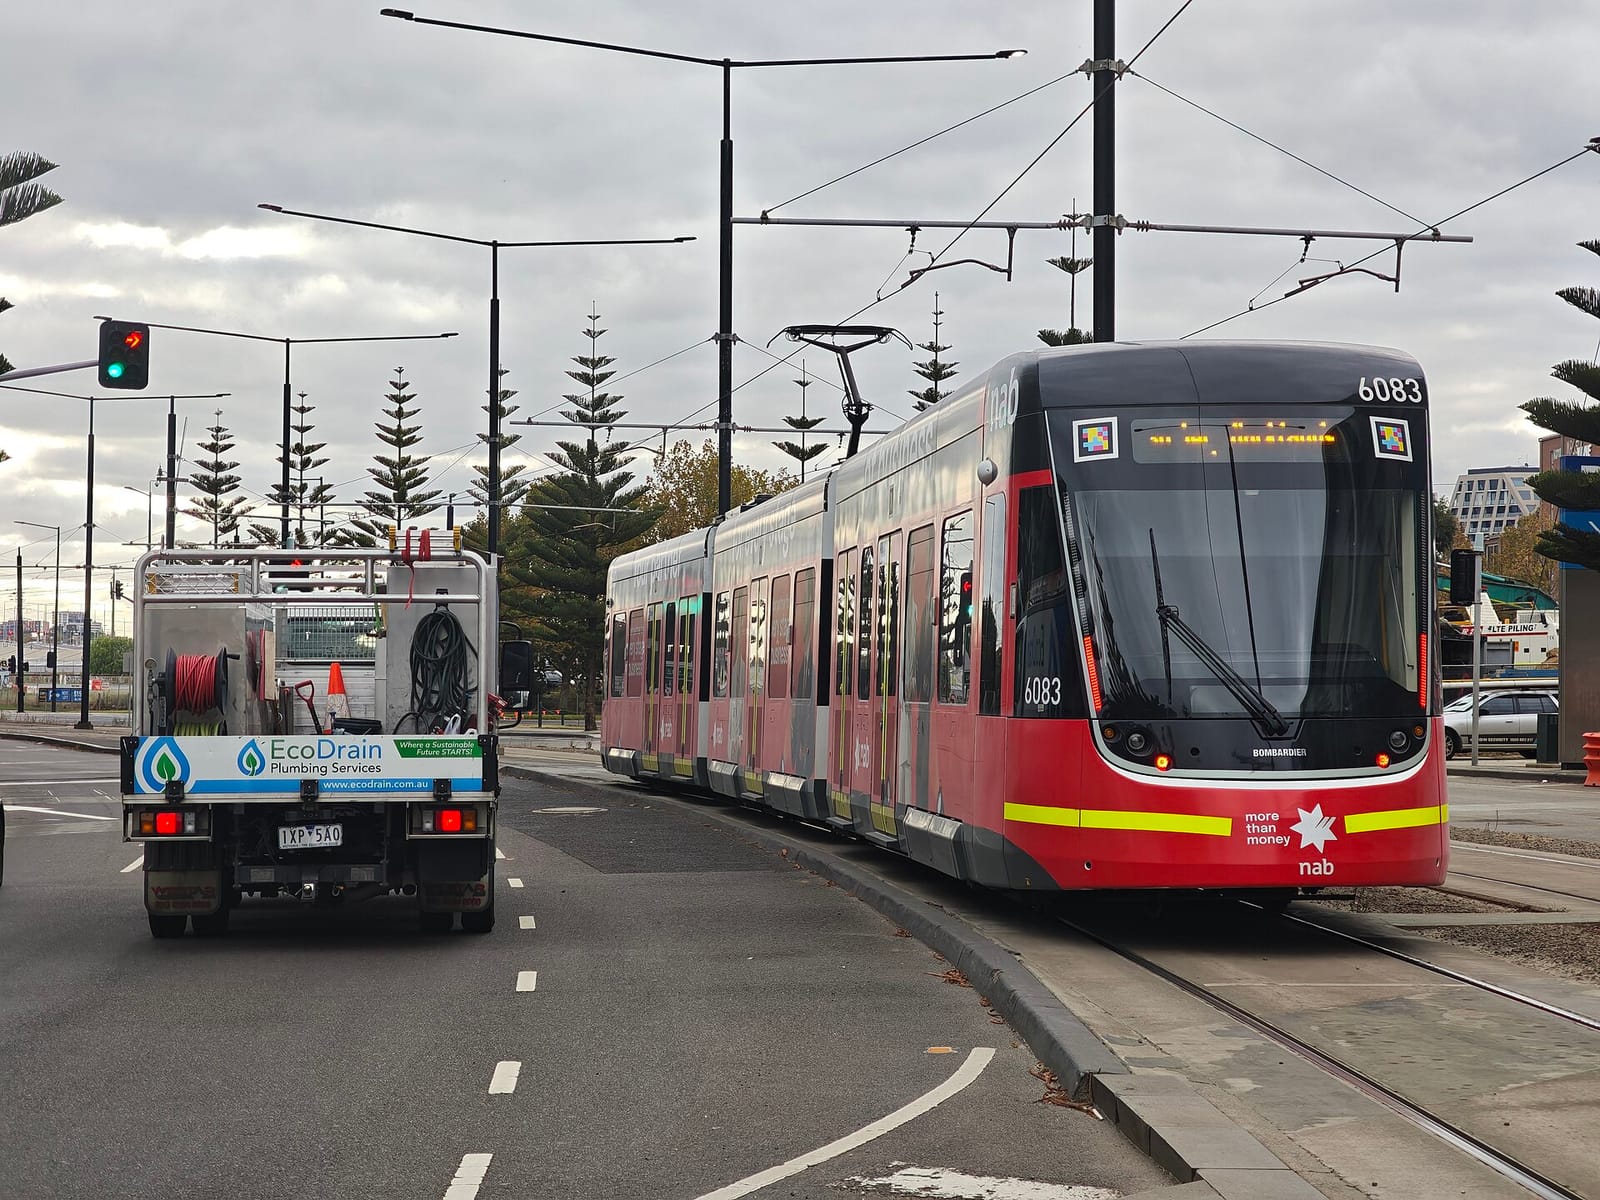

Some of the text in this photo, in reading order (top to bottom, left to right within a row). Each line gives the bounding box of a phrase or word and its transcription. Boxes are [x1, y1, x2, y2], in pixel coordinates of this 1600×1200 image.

[1357, 376, 1423, 404] 6083
[1508, 624, 1534, 632] PILING
[1024, 676, 1061, 706] 6083
[271, 739, 382, 760] EcoDrain
[399, 741, 423, 749] Where
[432, 741, 475, 749] Sustainable
[416, 748, 473, 756] Future STARTS!
[1253, 747, 1307, 758] BOMBARDIER
[270, 762, 382, 776] Plumbing Services
[323, 780, 428, 789] www.ecodrain.com.au
[1245, 812, 1280, 821] more
[1245, 823, 1277, 833] than
[1246, 835, 1291, 847] money
[1298, 859, 1334, 876] nab
